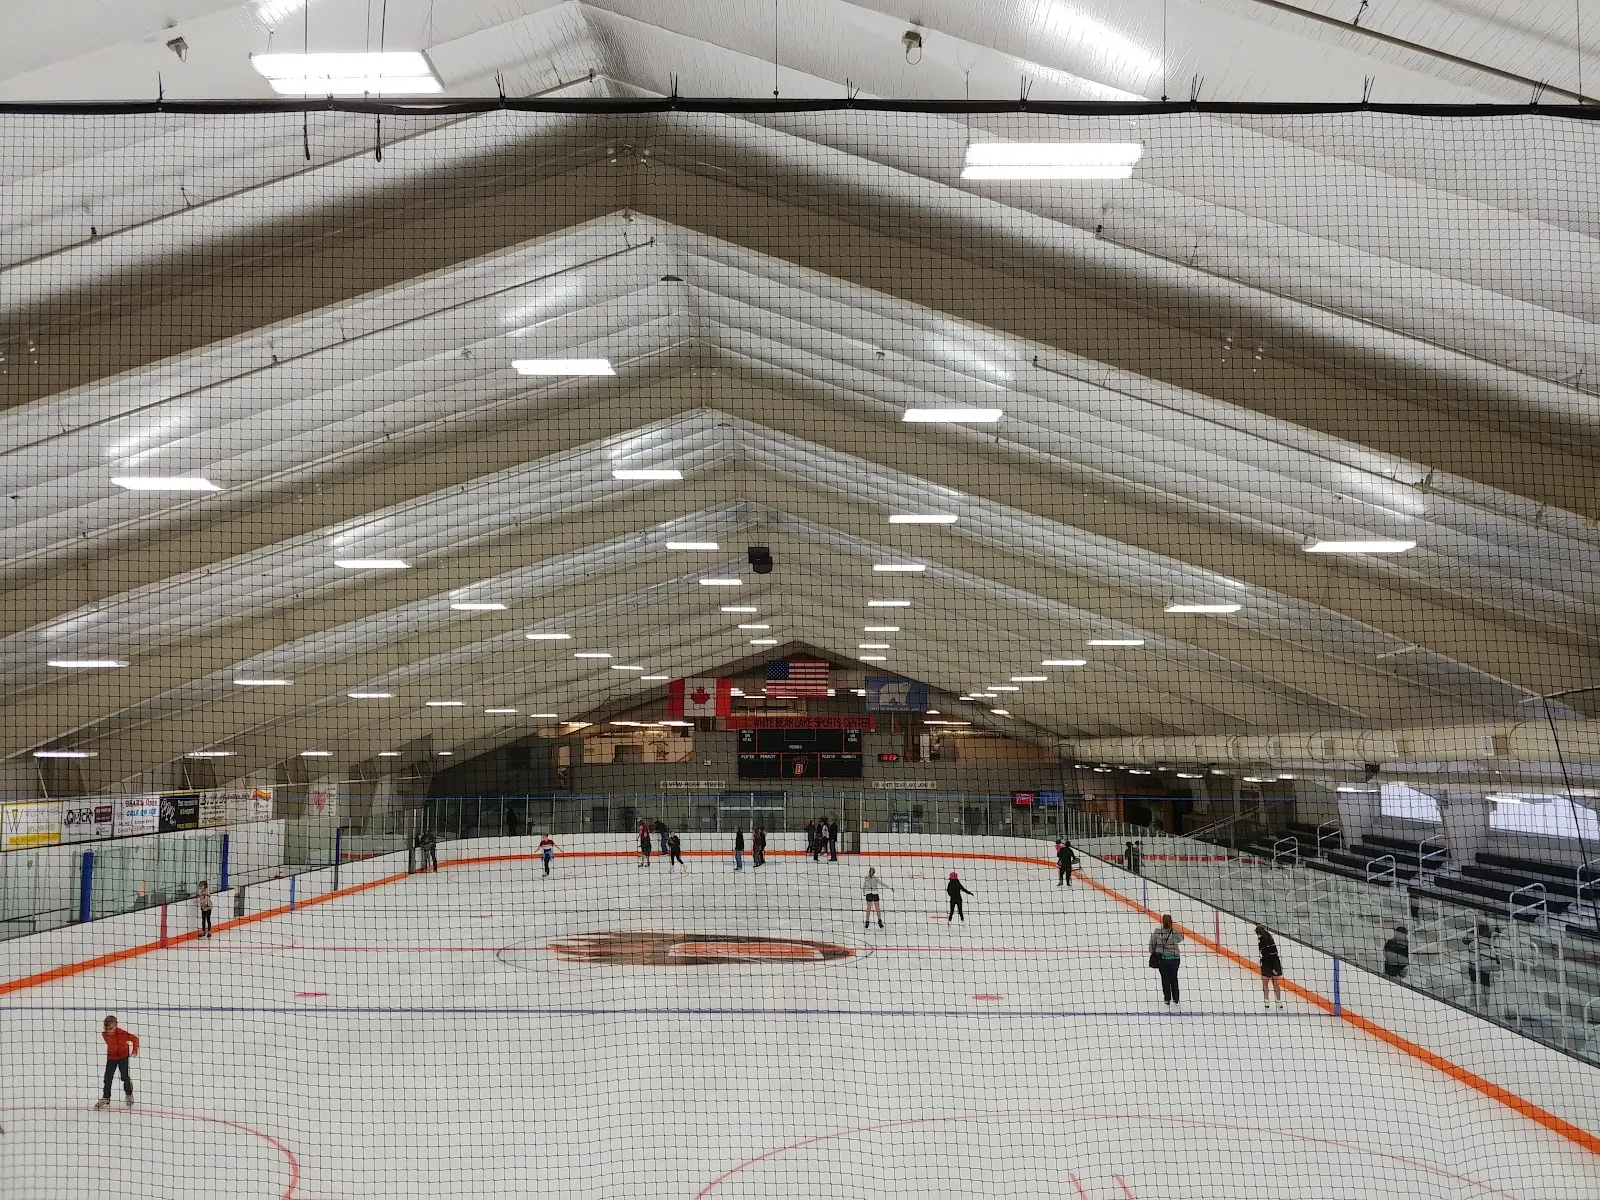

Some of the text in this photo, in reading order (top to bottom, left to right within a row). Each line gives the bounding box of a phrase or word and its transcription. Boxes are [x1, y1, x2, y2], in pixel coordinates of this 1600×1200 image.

[754, 716, 870, 728] WHITE BEAR LAKE SPORTS CENTER
